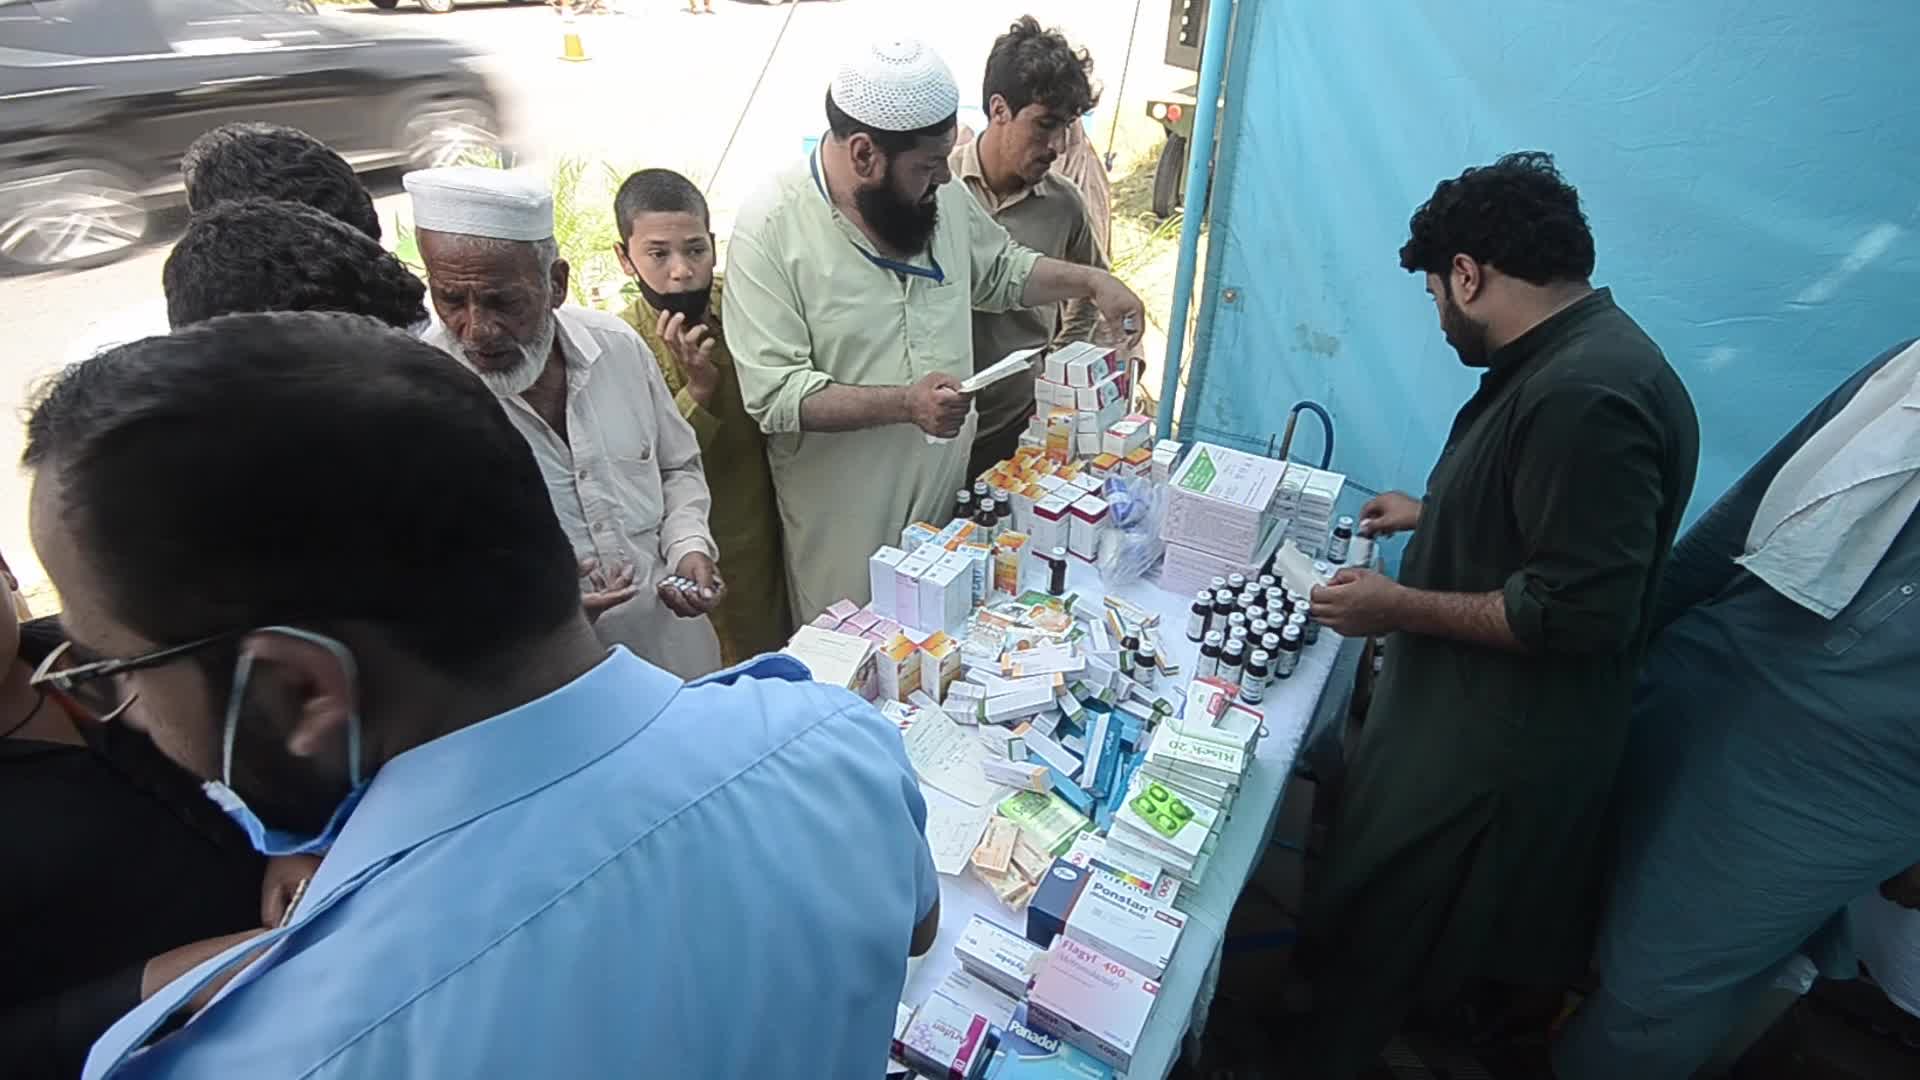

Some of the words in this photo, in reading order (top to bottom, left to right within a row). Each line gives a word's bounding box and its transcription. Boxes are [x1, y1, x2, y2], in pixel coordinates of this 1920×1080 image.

[1192, 745, 1234, 763] Risek
[1092, 882, 1150, 913] Ponstan
[1062, 940, 1098, 964] Flagyl
[1104, 961, 1126, 978] 400
[1009, 1020, 1059, 1052] Panadol
